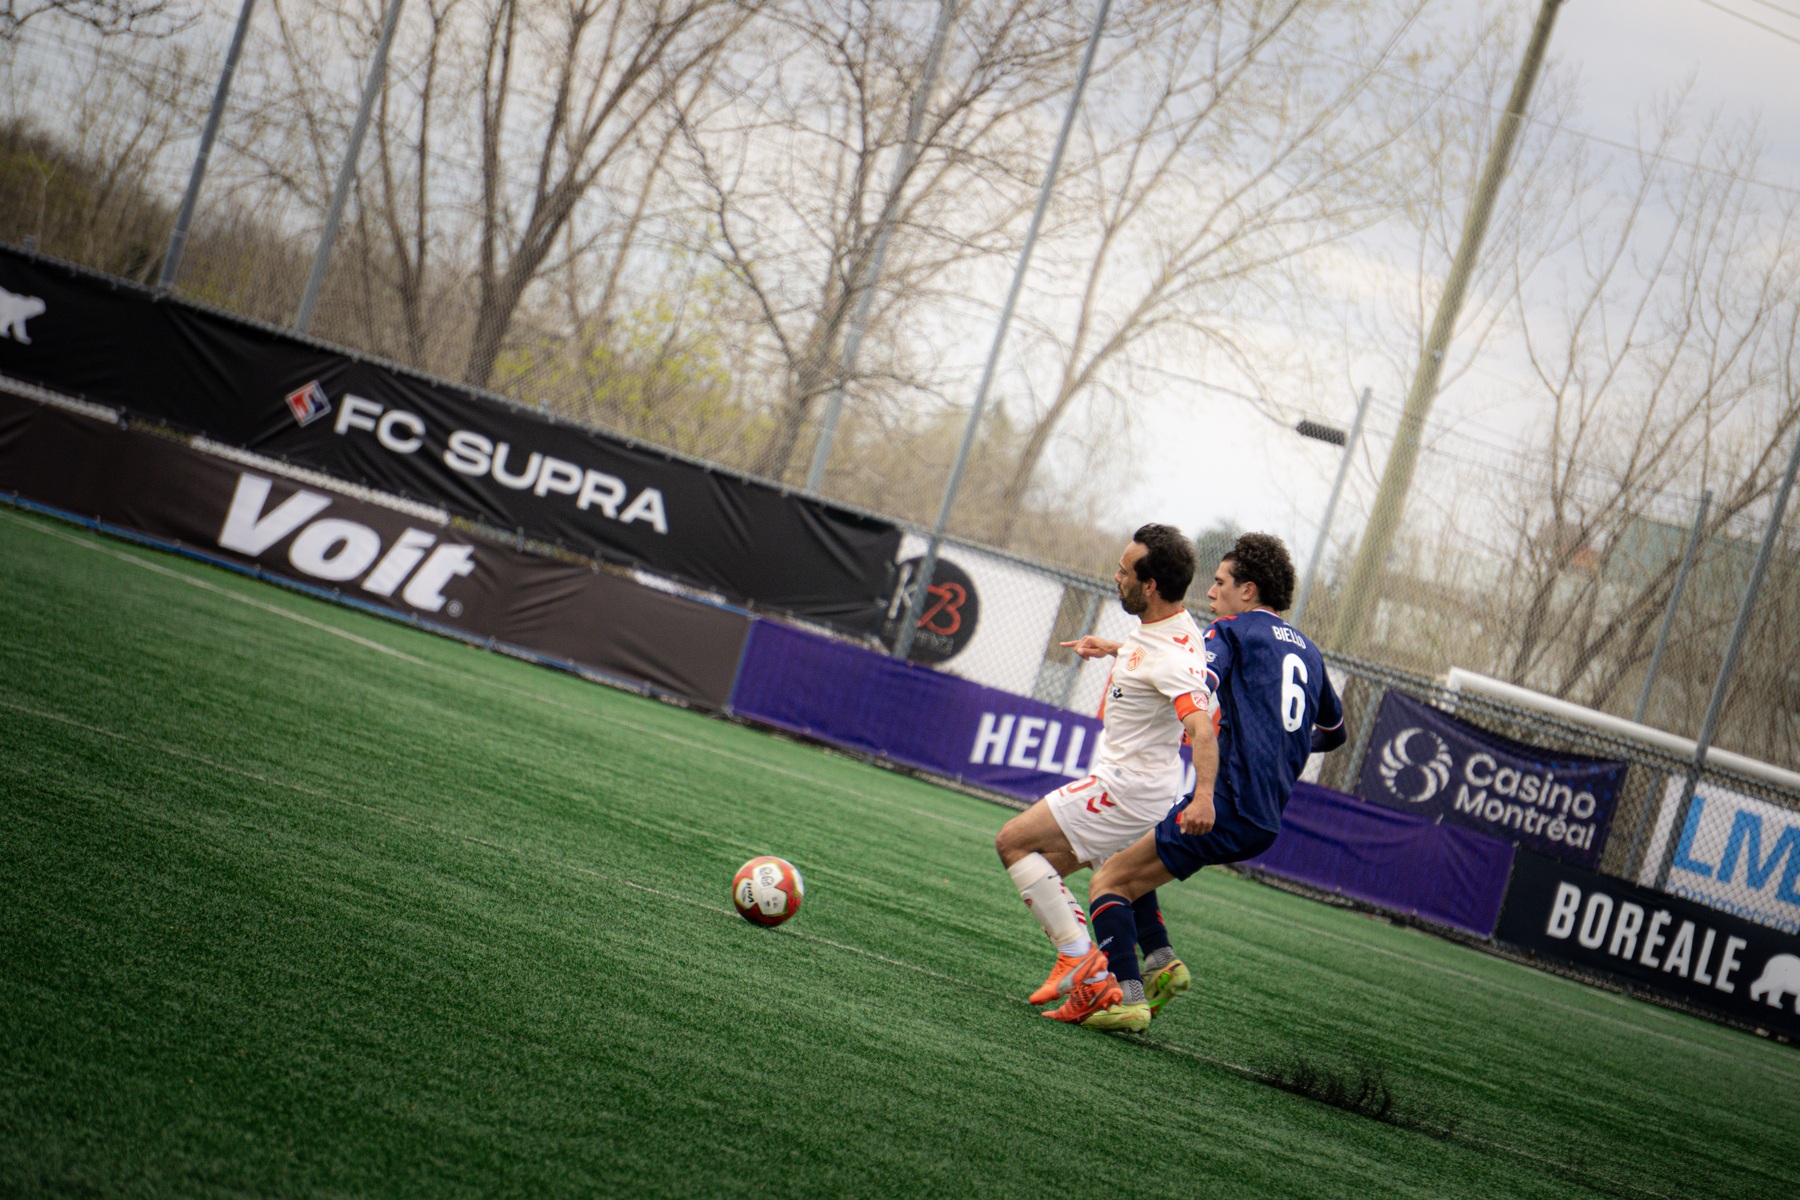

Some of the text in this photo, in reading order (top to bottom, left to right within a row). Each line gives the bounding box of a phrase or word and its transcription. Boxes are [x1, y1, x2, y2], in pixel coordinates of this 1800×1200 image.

[334, 393, 668, 534] FC SUPRA
[217, 472, 476, 612] Voit
[1272, 625, 1306, 650] BIELLO
[1281, 653, 1308, 733] 6
[1454, 784, 1597, 850] Montréal
[1464, 752, 1597, 819] Casino
[1673, 795, 1800, 907] LM
[1546, 880, 1748, 994] BORÉALE
